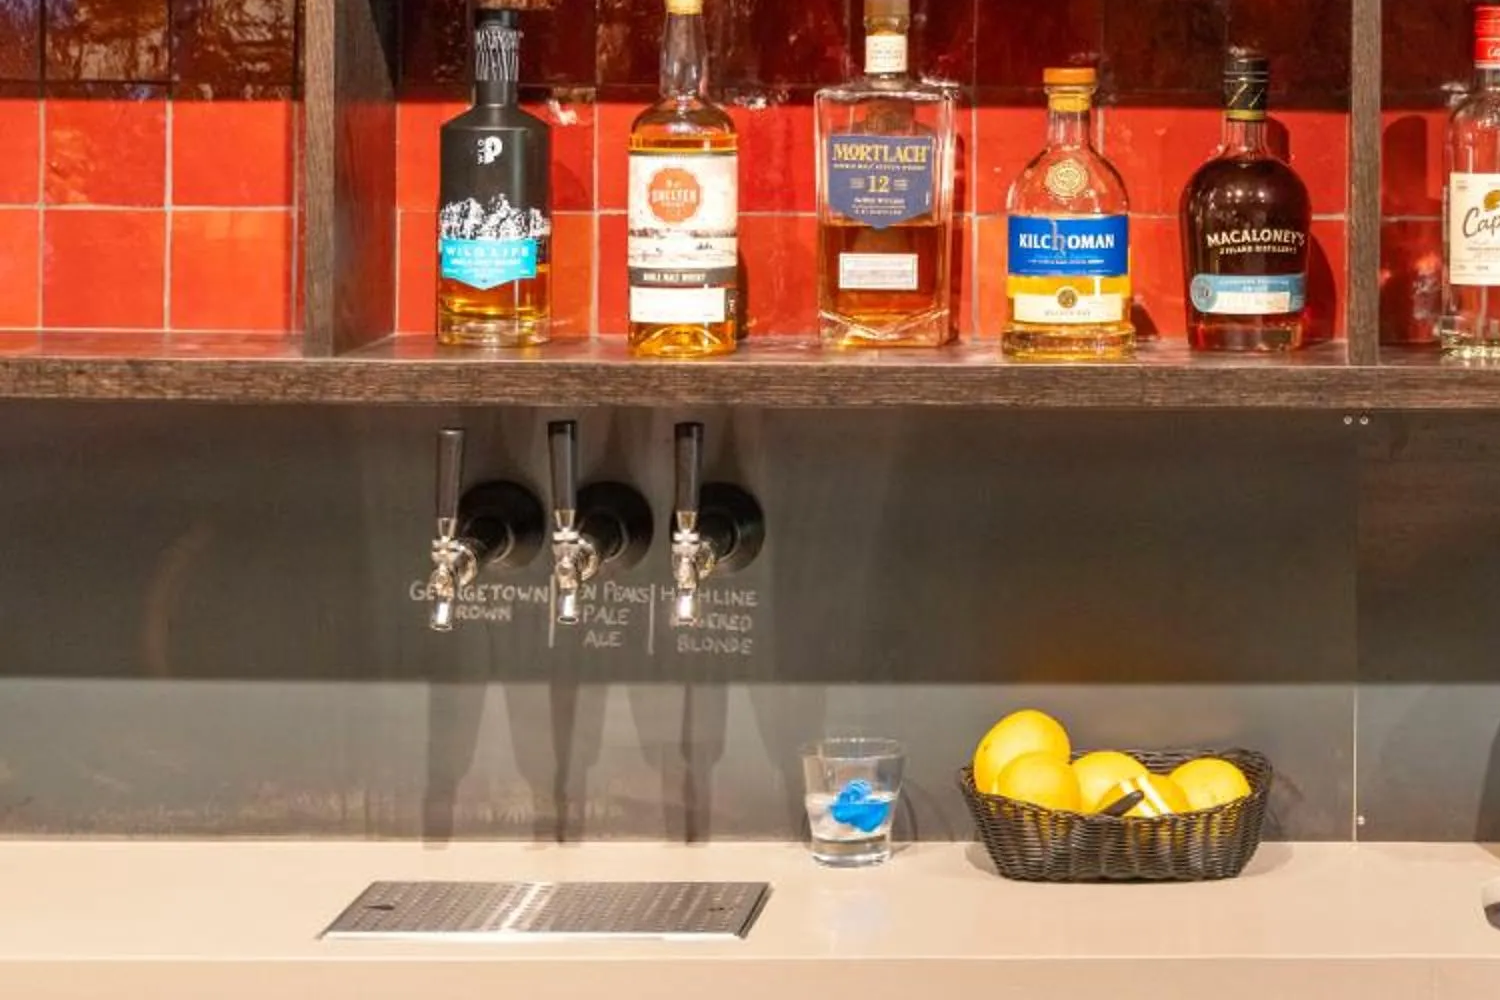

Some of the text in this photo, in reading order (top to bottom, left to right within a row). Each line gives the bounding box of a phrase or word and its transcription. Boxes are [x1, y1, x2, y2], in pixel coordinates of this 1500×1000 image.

[832, 143, 929, 163] MORTLACH
[867, 175, 890, 193] 12
[661, 585, 758, 607] HHLINE
[455, 604, 513, 621] ROWN
[582, 604, 631, 626] PALE
[583, 630, 622, 648] ALE
